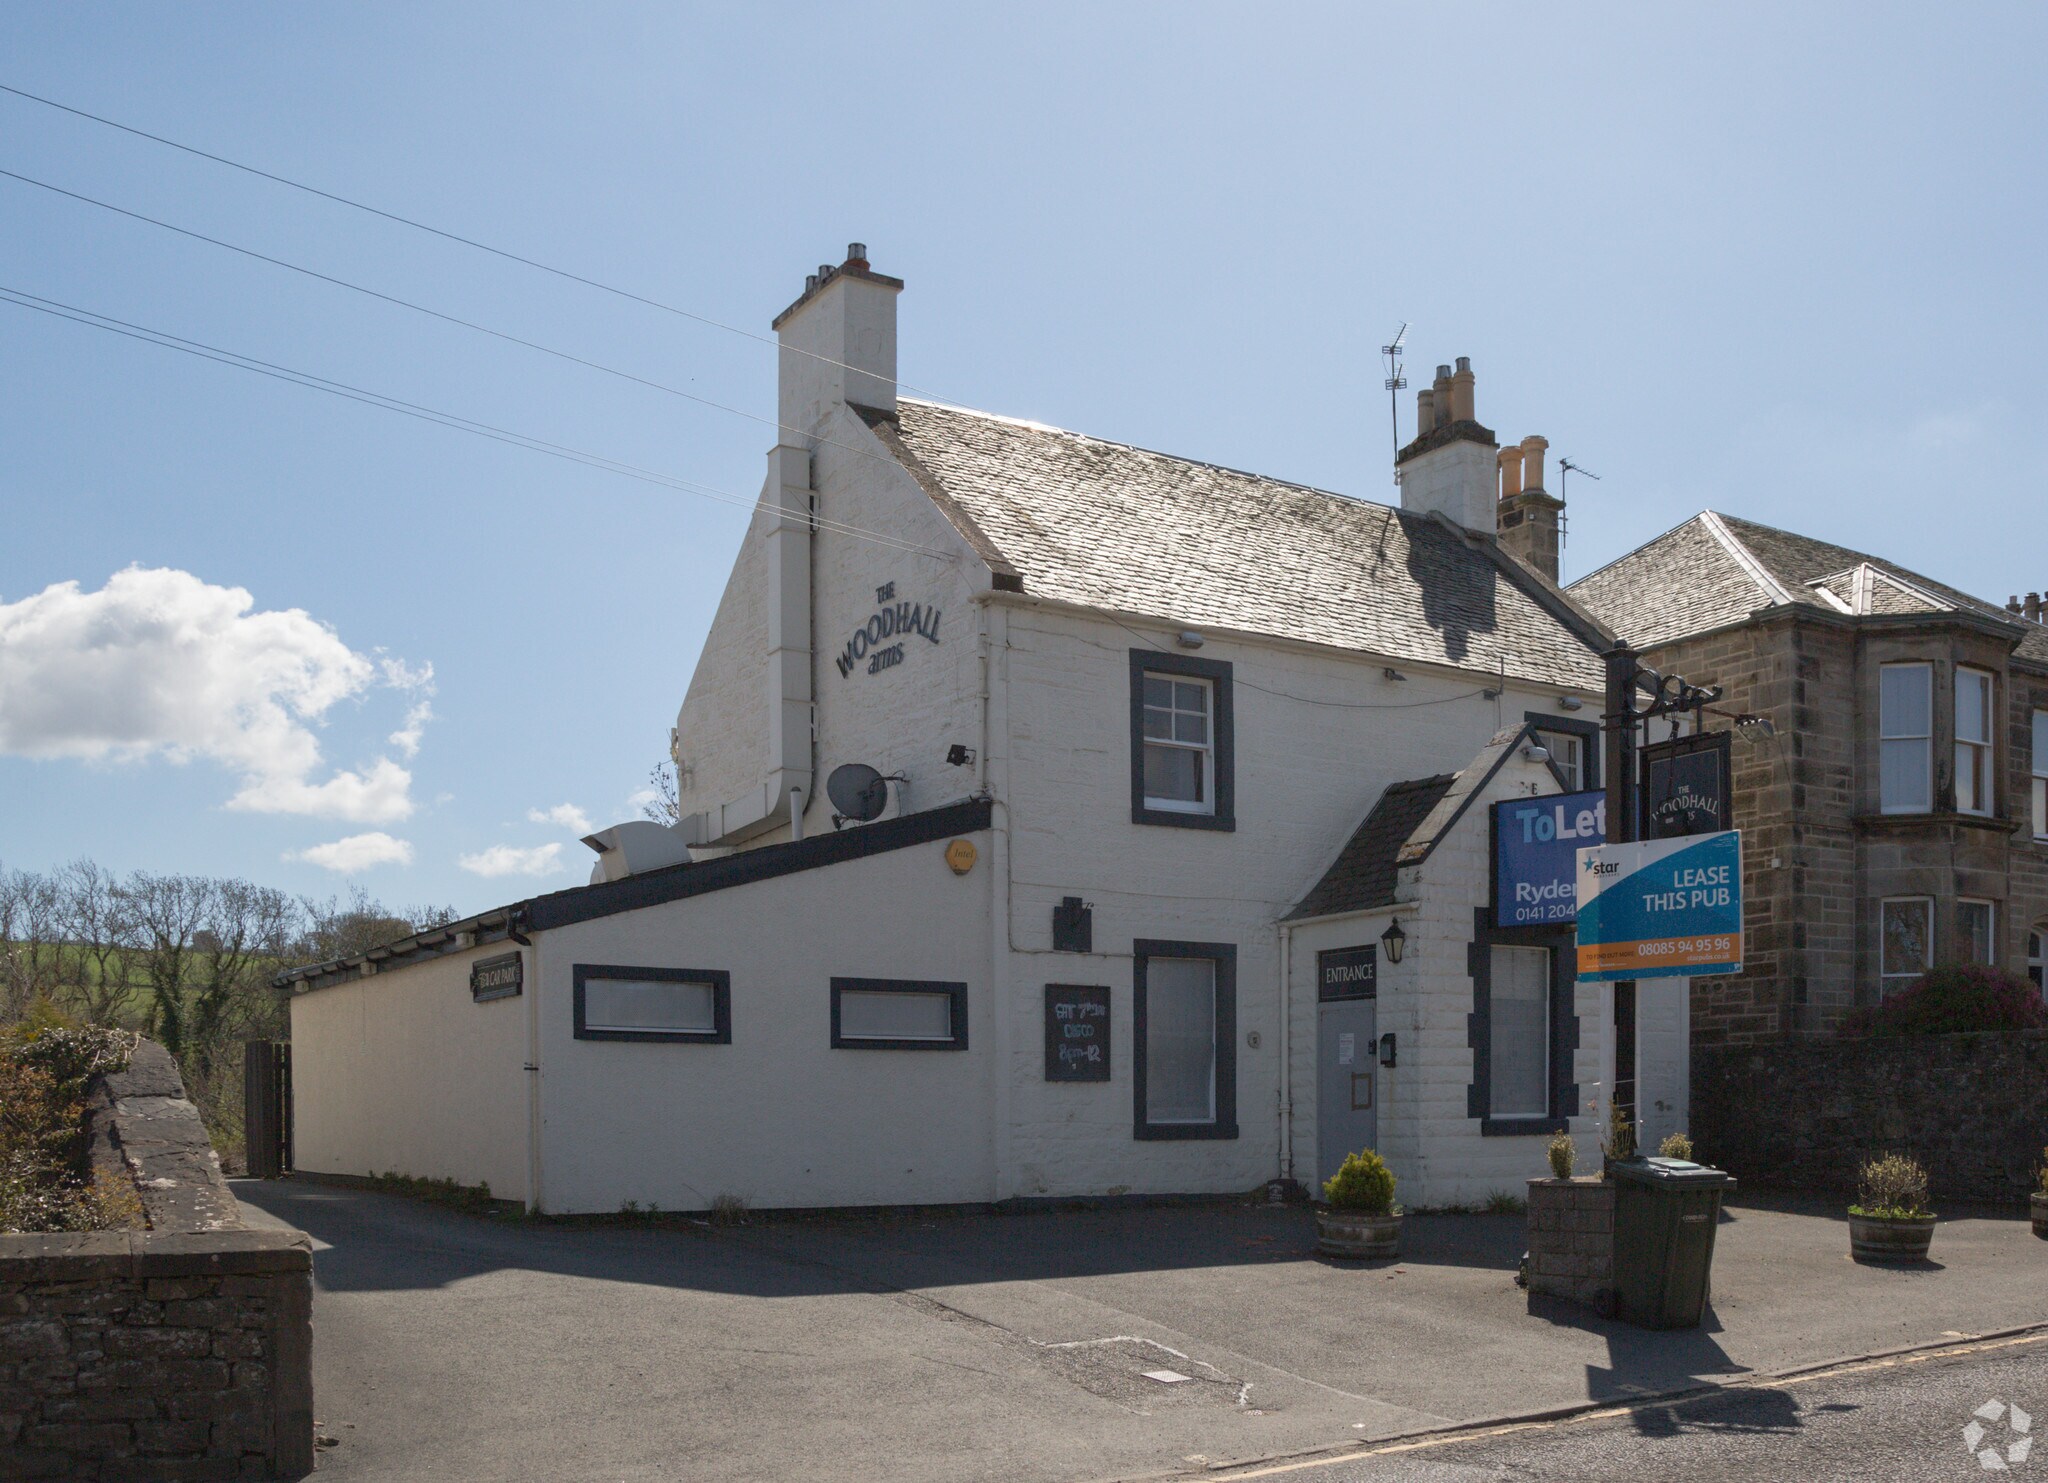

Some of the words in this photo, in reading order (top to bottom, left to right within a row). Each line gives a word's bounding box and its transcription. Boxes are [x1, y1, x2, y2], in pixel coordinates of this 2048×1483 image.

[876, 581, 895, 604] THE
[836, 602, 941, 679] WOODHALL
[868, 642, 904, 675] arms
[1678, 785, 1690, 794] THE
[1593, 861, 1620, 875] star
[1674, 866, 1730, 888] LEASE
[1643, 891, 1686, 912] THIS
[1691, 888, 1730, 908] PUB
[1516, 905, 1544, 921] 0141
[1548, 904, 1576, 918] 204
[1638, 941, 1675, 956] 08085
[1678, 940, 1693, 953] 94
[1696, 938, 1712, 952] 95
[1714, 937, 1730, 951] 96
[490, 969, 500, 986] CAR
[500, 965, 516, 984] PARK
[1326, 963, 1373, 984] ENTRANCE
